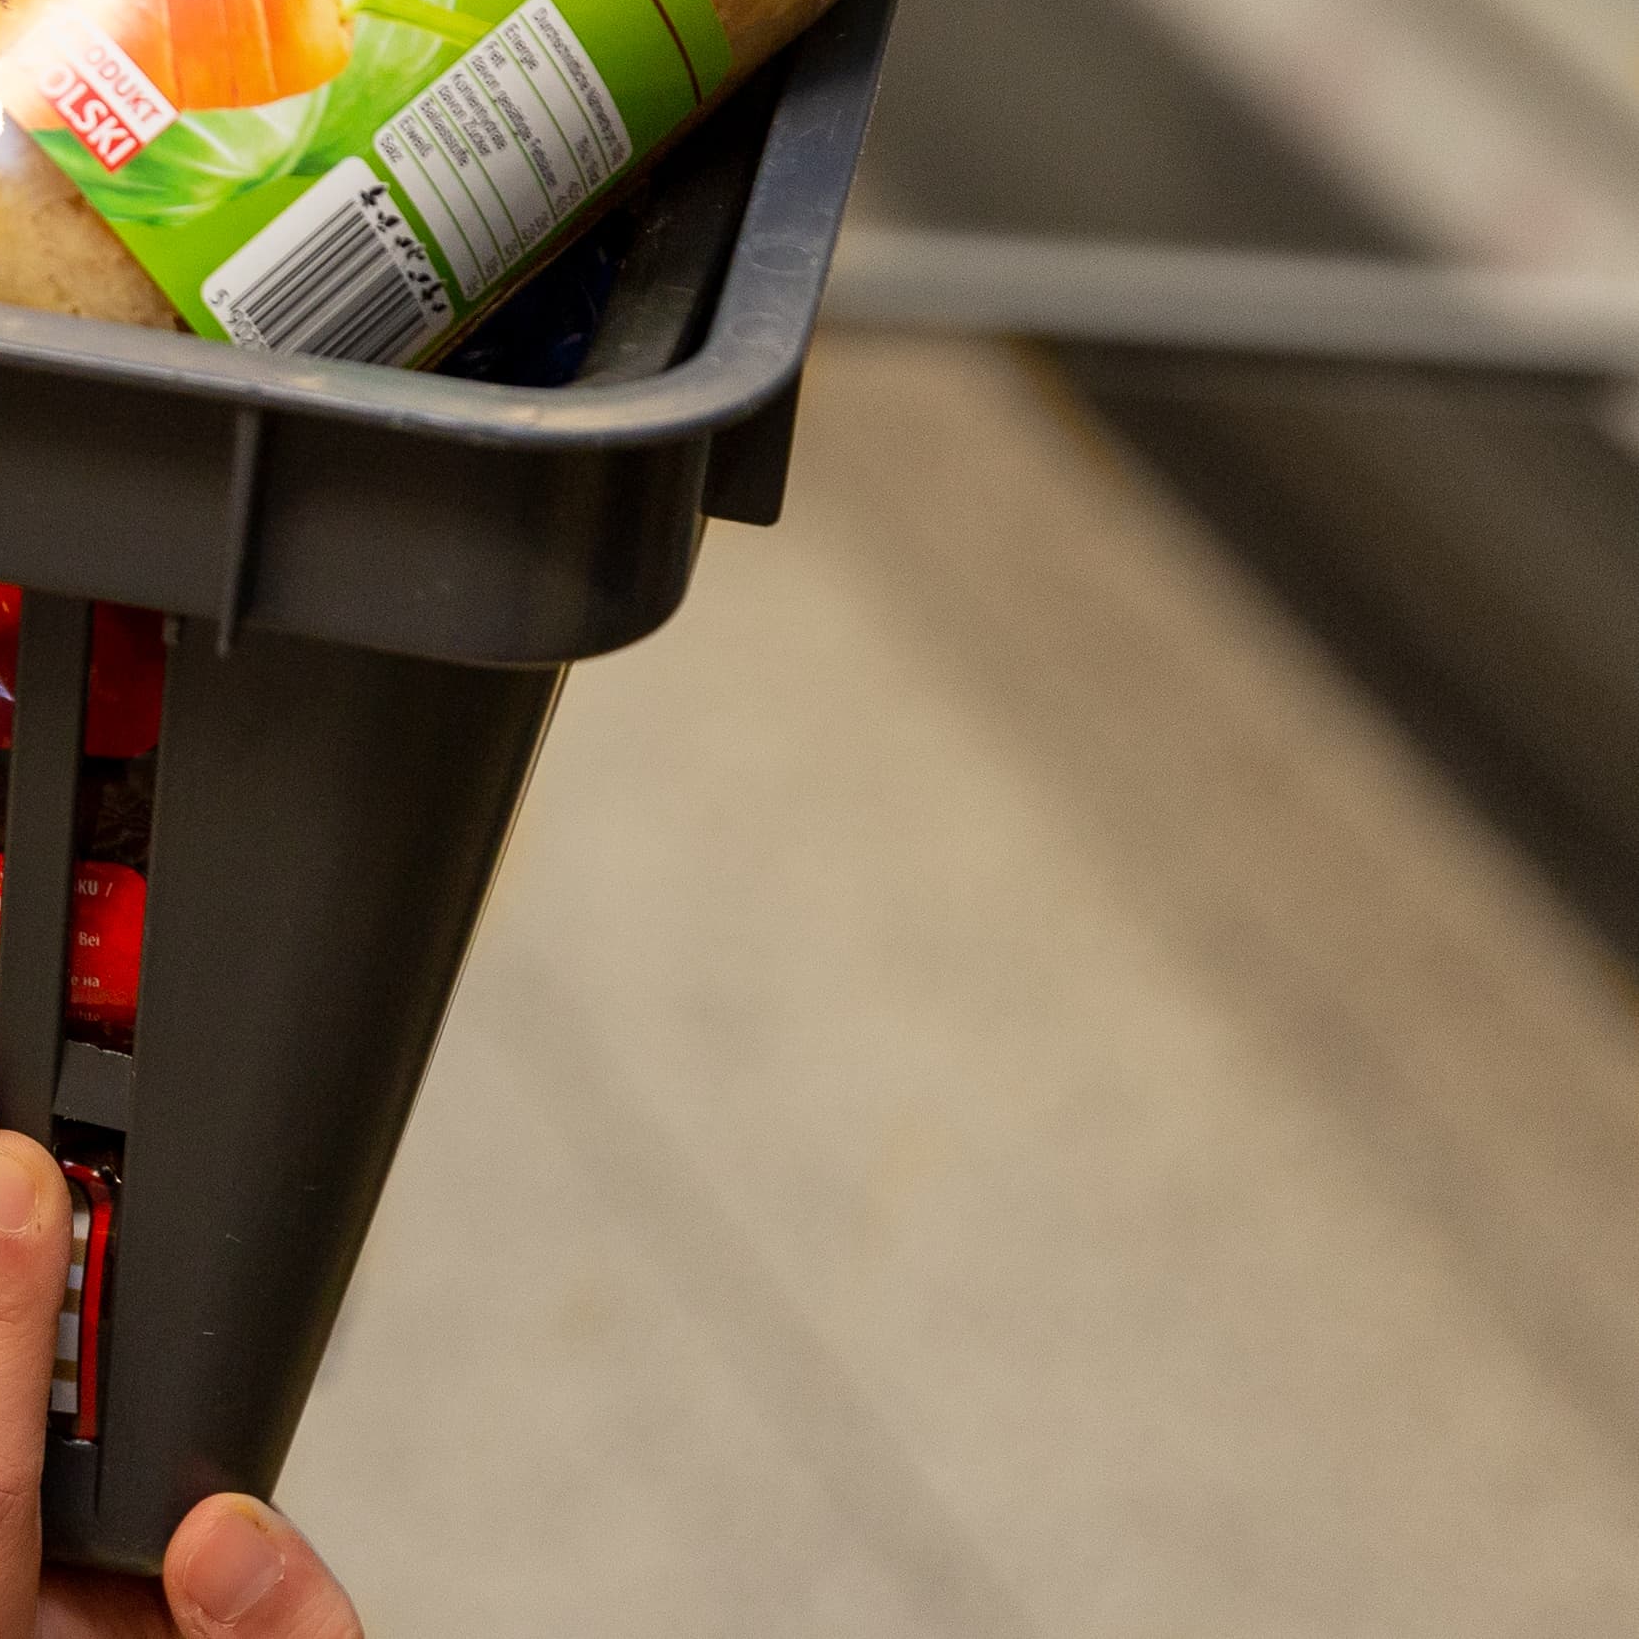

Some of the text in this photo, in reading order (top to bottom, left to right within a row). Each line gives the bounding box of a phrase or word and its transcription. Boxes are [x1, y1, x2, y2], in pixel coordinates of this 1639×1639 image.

[39, 62, 137, 165] OLSKI
[83, 43, 163, 123] ODUKT
[78, 931, 101, 947] Bei
